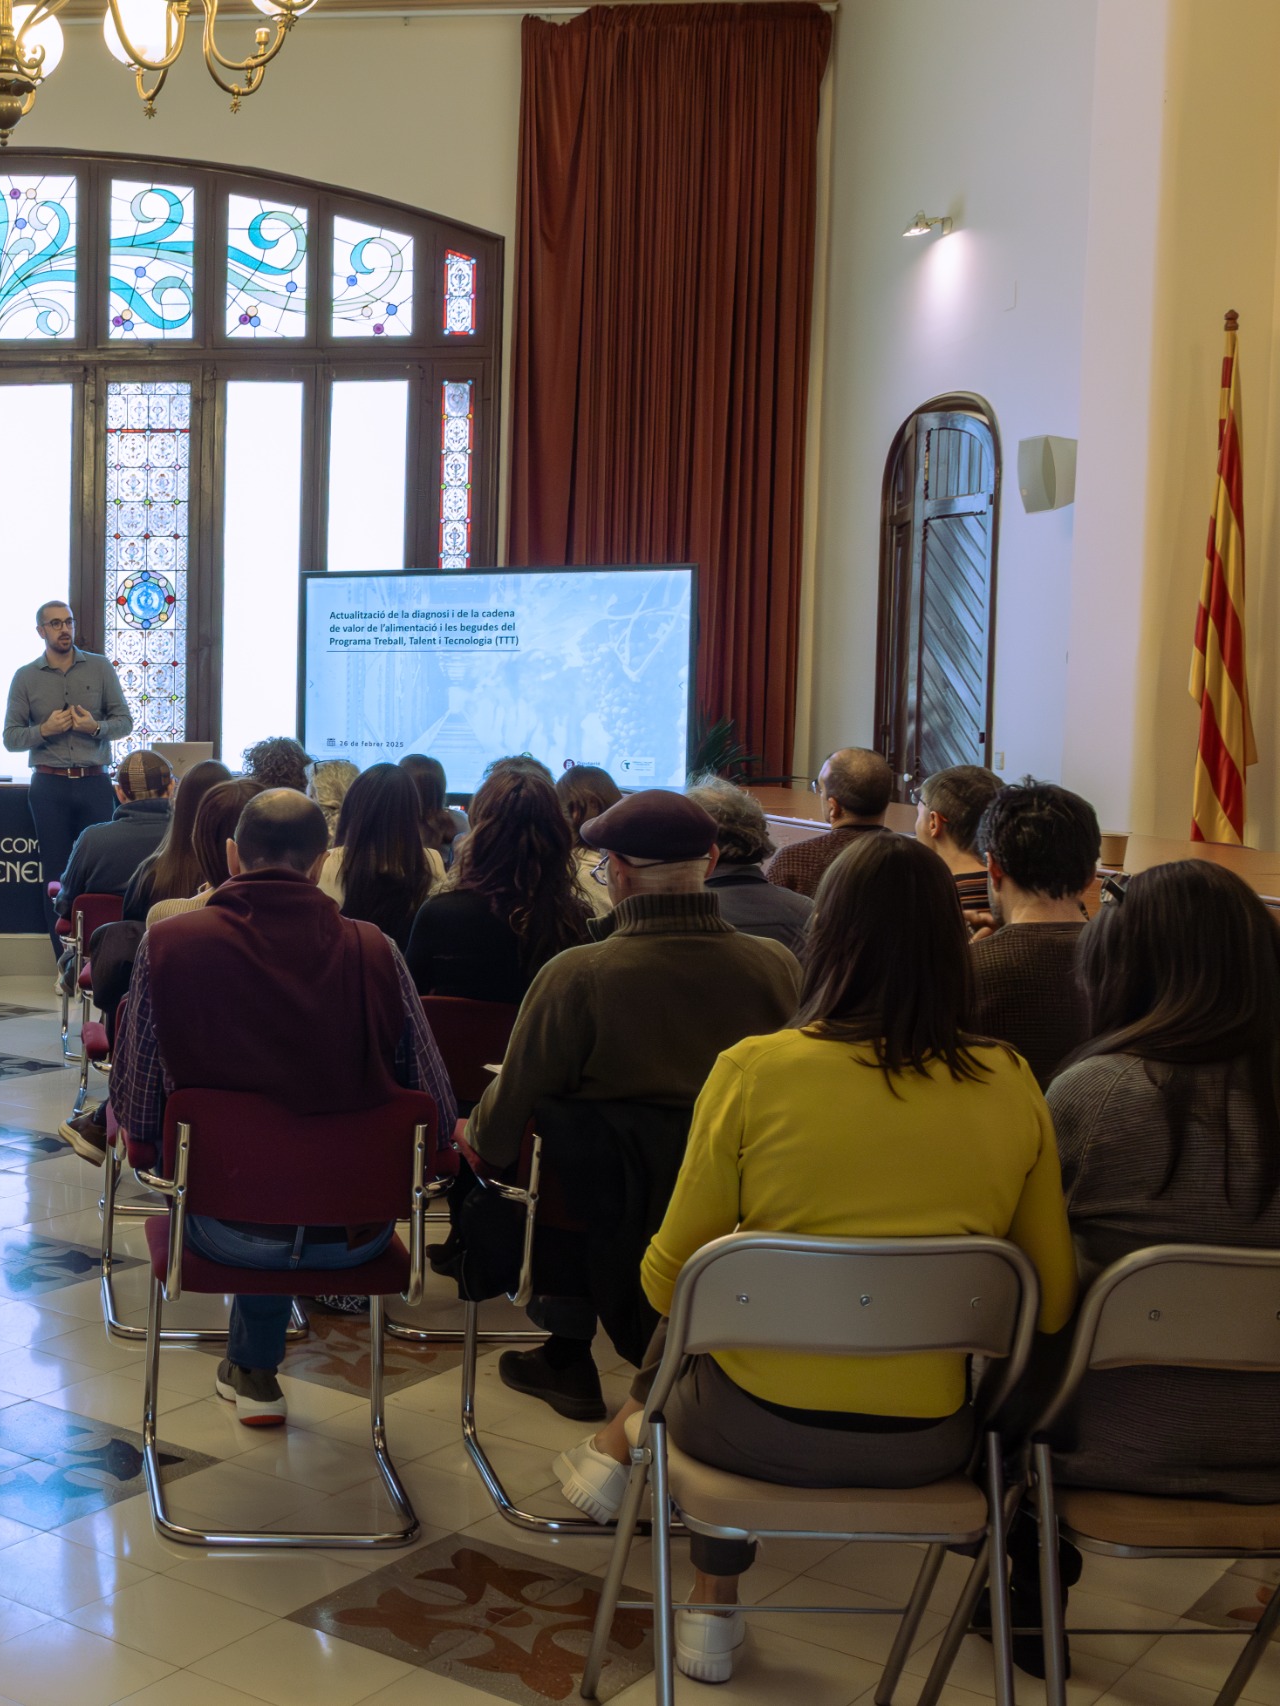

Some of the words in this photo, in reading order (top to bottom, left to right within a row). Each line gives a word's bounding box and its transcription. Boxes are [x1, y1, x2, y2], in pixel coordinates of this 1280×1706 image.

[329, 610, 386, 620] Actualització
[387, 610, 399, 619] de
[401, 610, 410, 619] la
[411, 609, 450, 620] diagnosi
[456, 609, 469, 618] de
[470, 609, 479, 618] la
[481, 608, 515, 618] cadena
[329, 624, 341, 633] de
[342, 624, 365, 633] valor
[366, 624, 378, 632] de
[444, 623, 458, 632] les
[460, 623, 499, 634] begudes
[501, 622, 516, 631] del
[329, 637, 372, 648] Programa
[373, 637, 407, 646] Treball,
[409, 636, 437, 645] Talent
[443, 636, 493, 647] Tecnologia
[495, 635, 519, 646] (TTT)
[0, 837, 40, 854] COM
